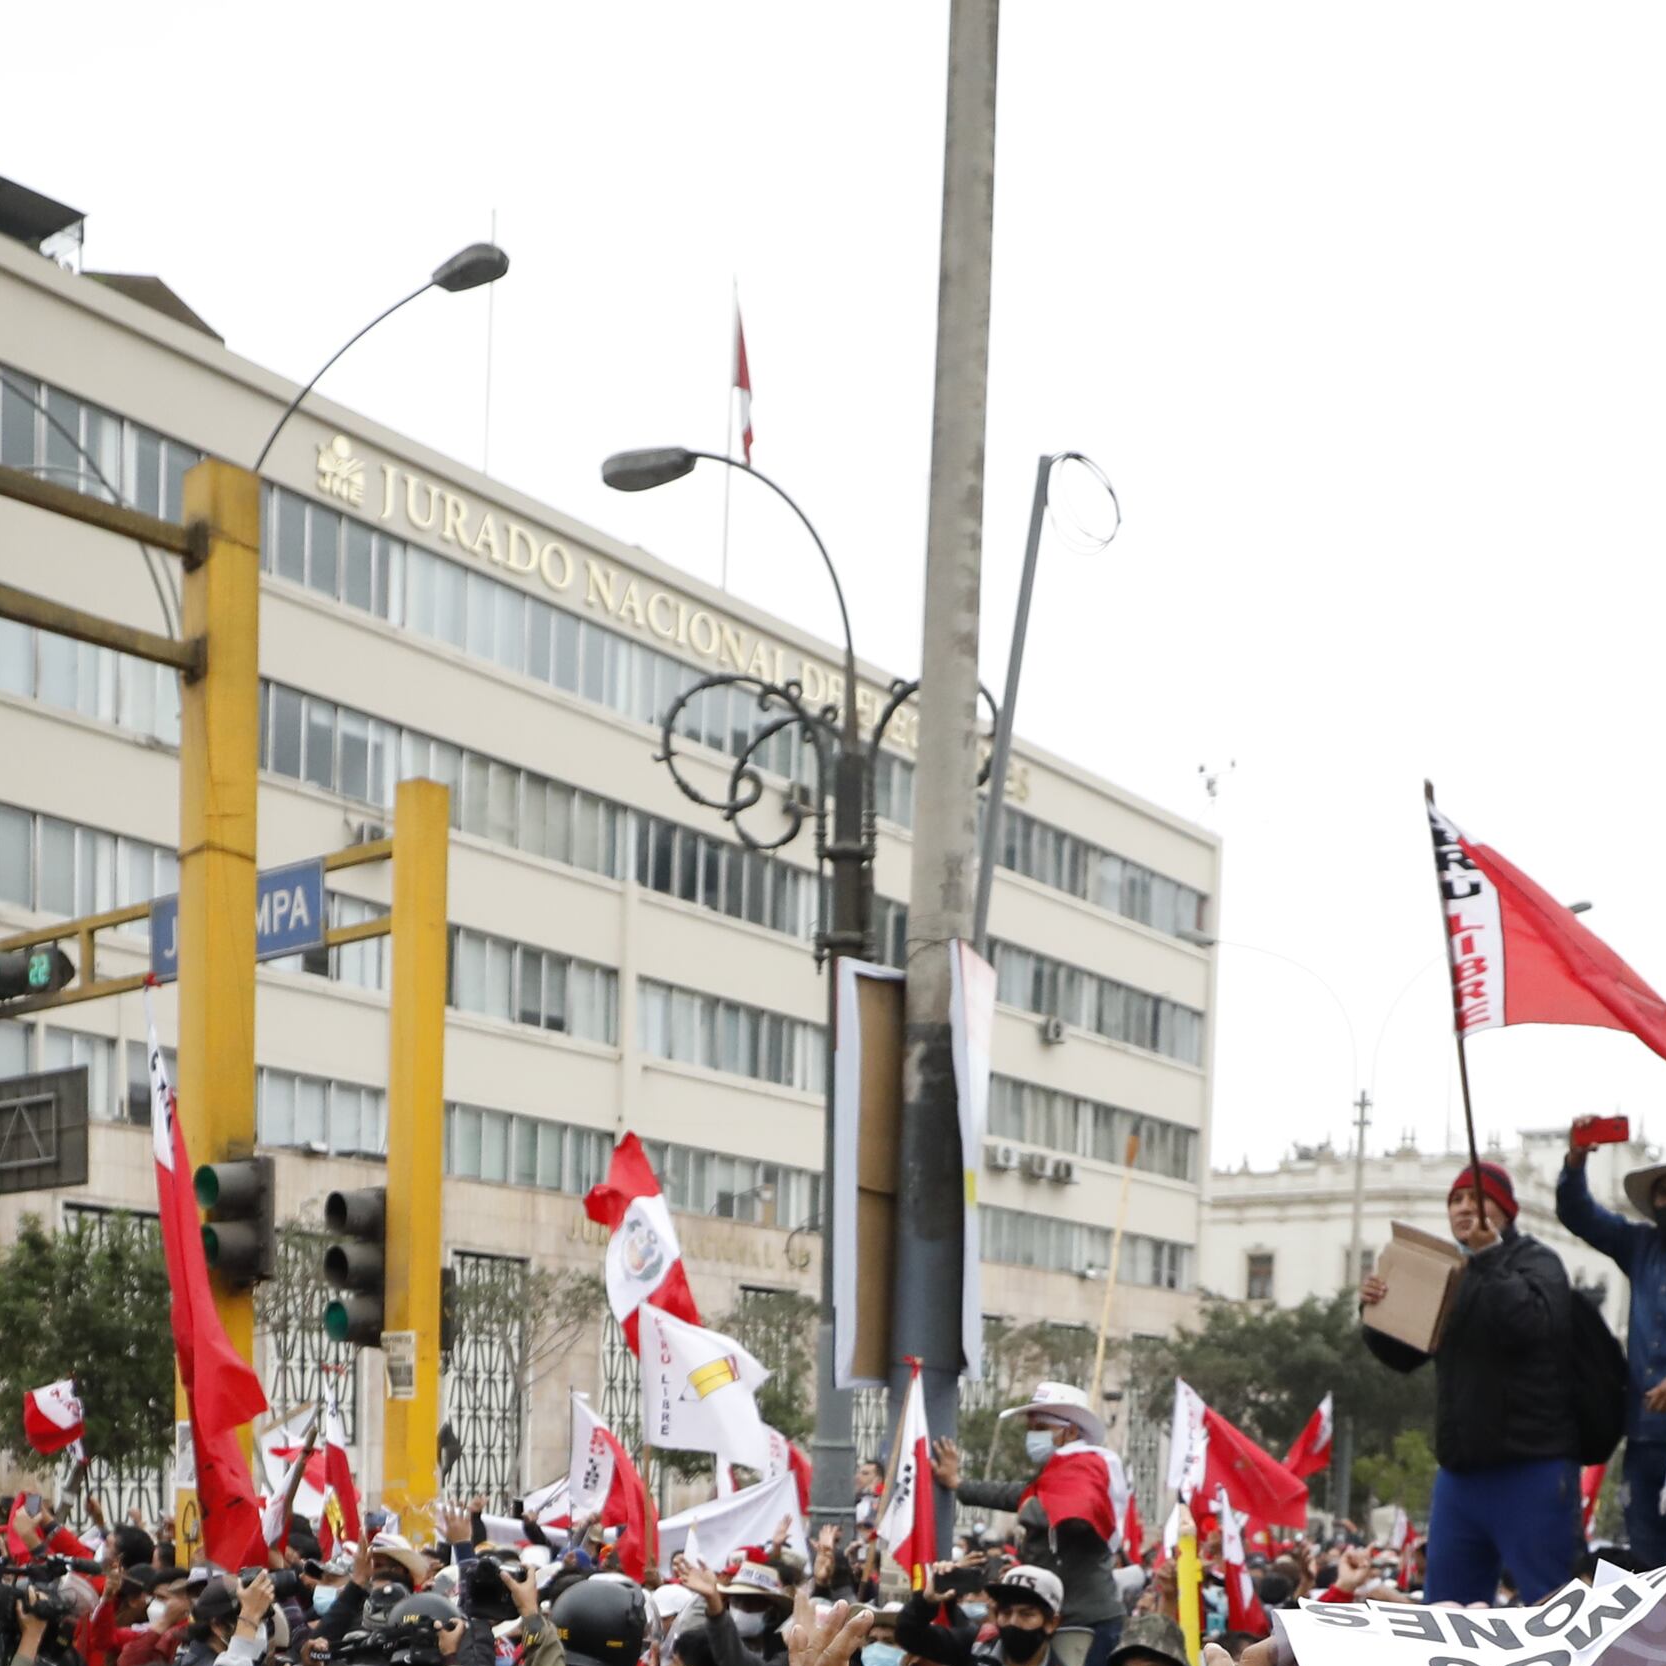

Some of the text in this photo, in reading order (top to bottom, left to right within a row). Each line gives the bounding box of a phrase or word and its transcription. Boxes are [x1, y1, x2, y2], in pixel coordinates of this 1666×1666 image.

[381, 463, 574, 593] JURADO
[583, 558, 791, 690] NACIONAL
[1447, 912, 1490, 1033] LIBRE
[660, 1373, 671, 1437] LIBRE
